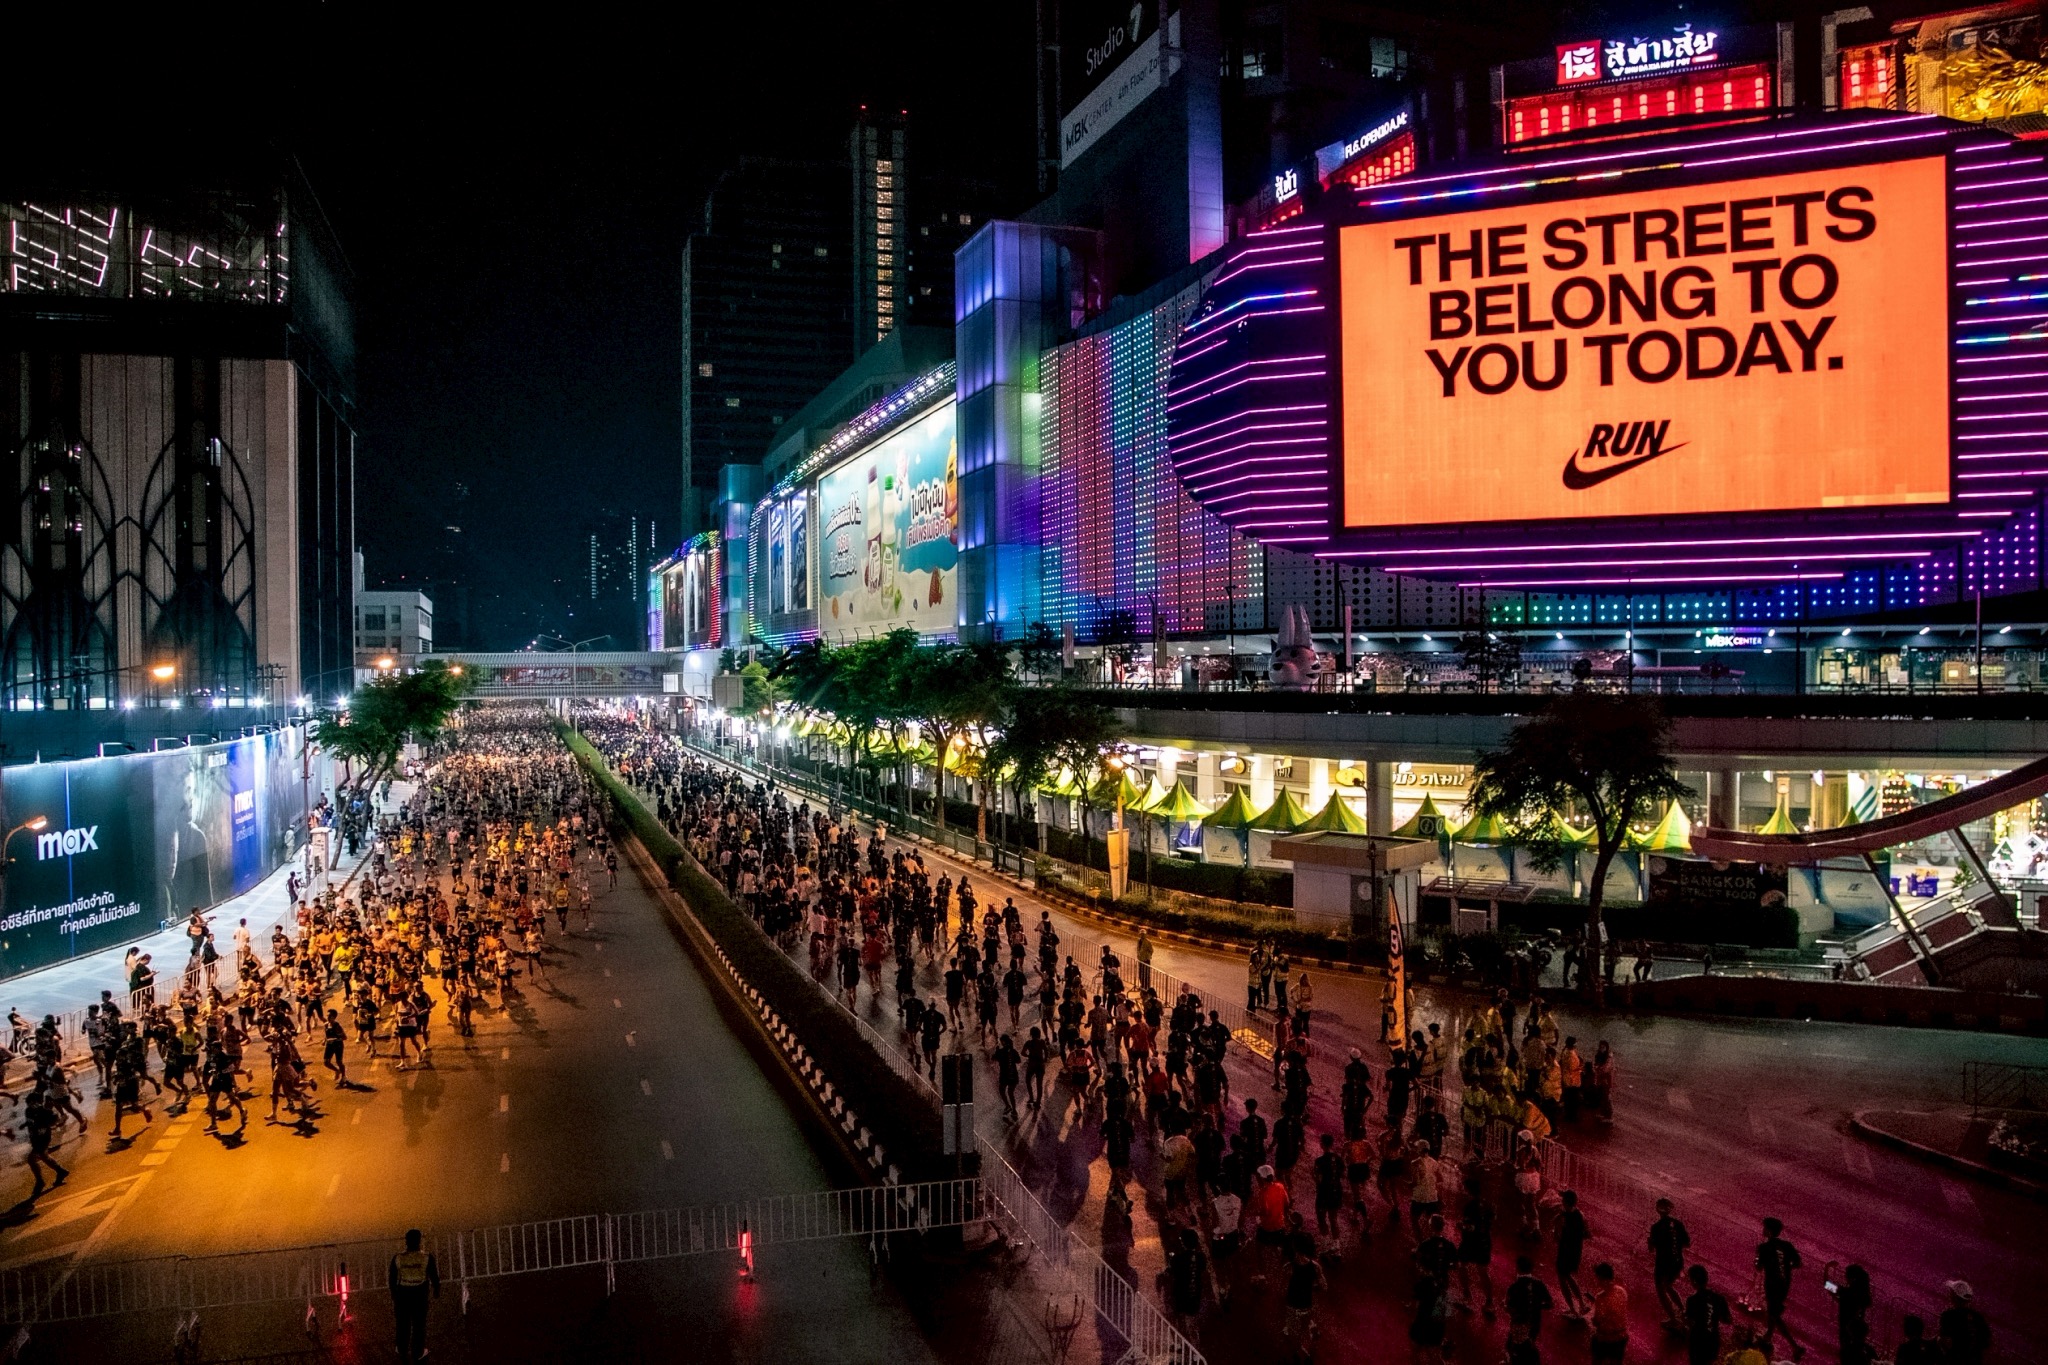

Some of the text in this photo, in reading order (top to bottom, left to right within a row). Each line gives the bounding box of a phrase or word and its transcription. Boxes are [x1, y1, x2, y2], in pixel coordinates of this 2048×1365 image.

[1086, 2, 1143, 76] Studio 7
[1661, 60, 1675, 69] HOT
[1676, 58, 1690, 67] POT
[1065, 114, 1088, 151] MBK
[1088, 97, 1113, 126] CENTER
[1118, 85, 1129, 99] 4th
[1130, 66, 1148, 88] Floor
[1360, 128, 1381, 149] OPEN
[1395, 186, 1877, 286] THE STREETS
[1429, 254, 1839, 340] BELONG TO
[1425, 315, 1844, 398] YOU TODAY.
[1583, 419, 1671, 457] RUN
[1705, 635, 1762, 647] MBK CENTER
[234, 789, 254, 814] max
[37, 825, 98, 861] max
[1680, 874, 1757, 889] BANGKOK
[1680, 887, 1757, 900] STREET FOOD
[60, 901, 140, 935] ทำคุณอินไม่มีวันลืม
